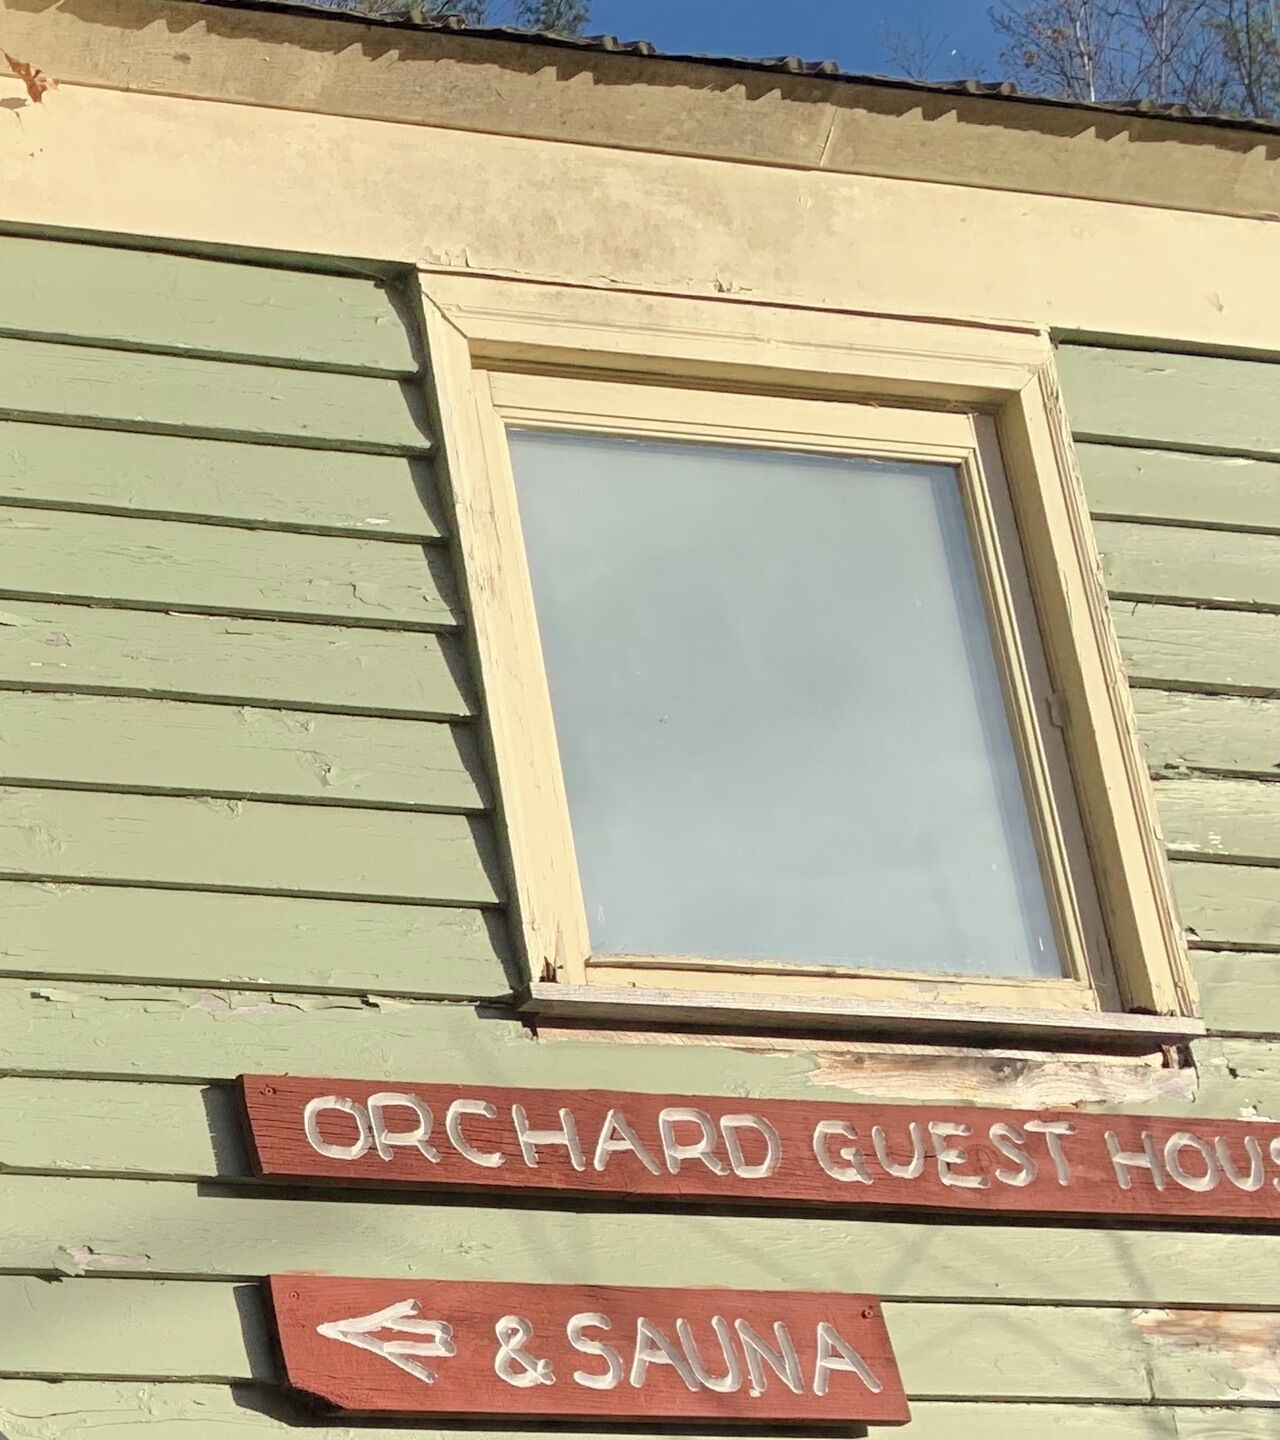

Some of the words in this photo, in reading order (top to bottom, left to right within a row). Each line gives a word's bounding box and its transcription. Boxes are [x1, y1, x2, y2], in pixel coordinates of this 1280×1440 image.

[304, 1092, 780, 1179] ORCHARD
[812, 1121, 1074, 1188] GUEST
[494, 1315, 553, 1387] &
[573, 1312, 882, 1397] SAUNA
